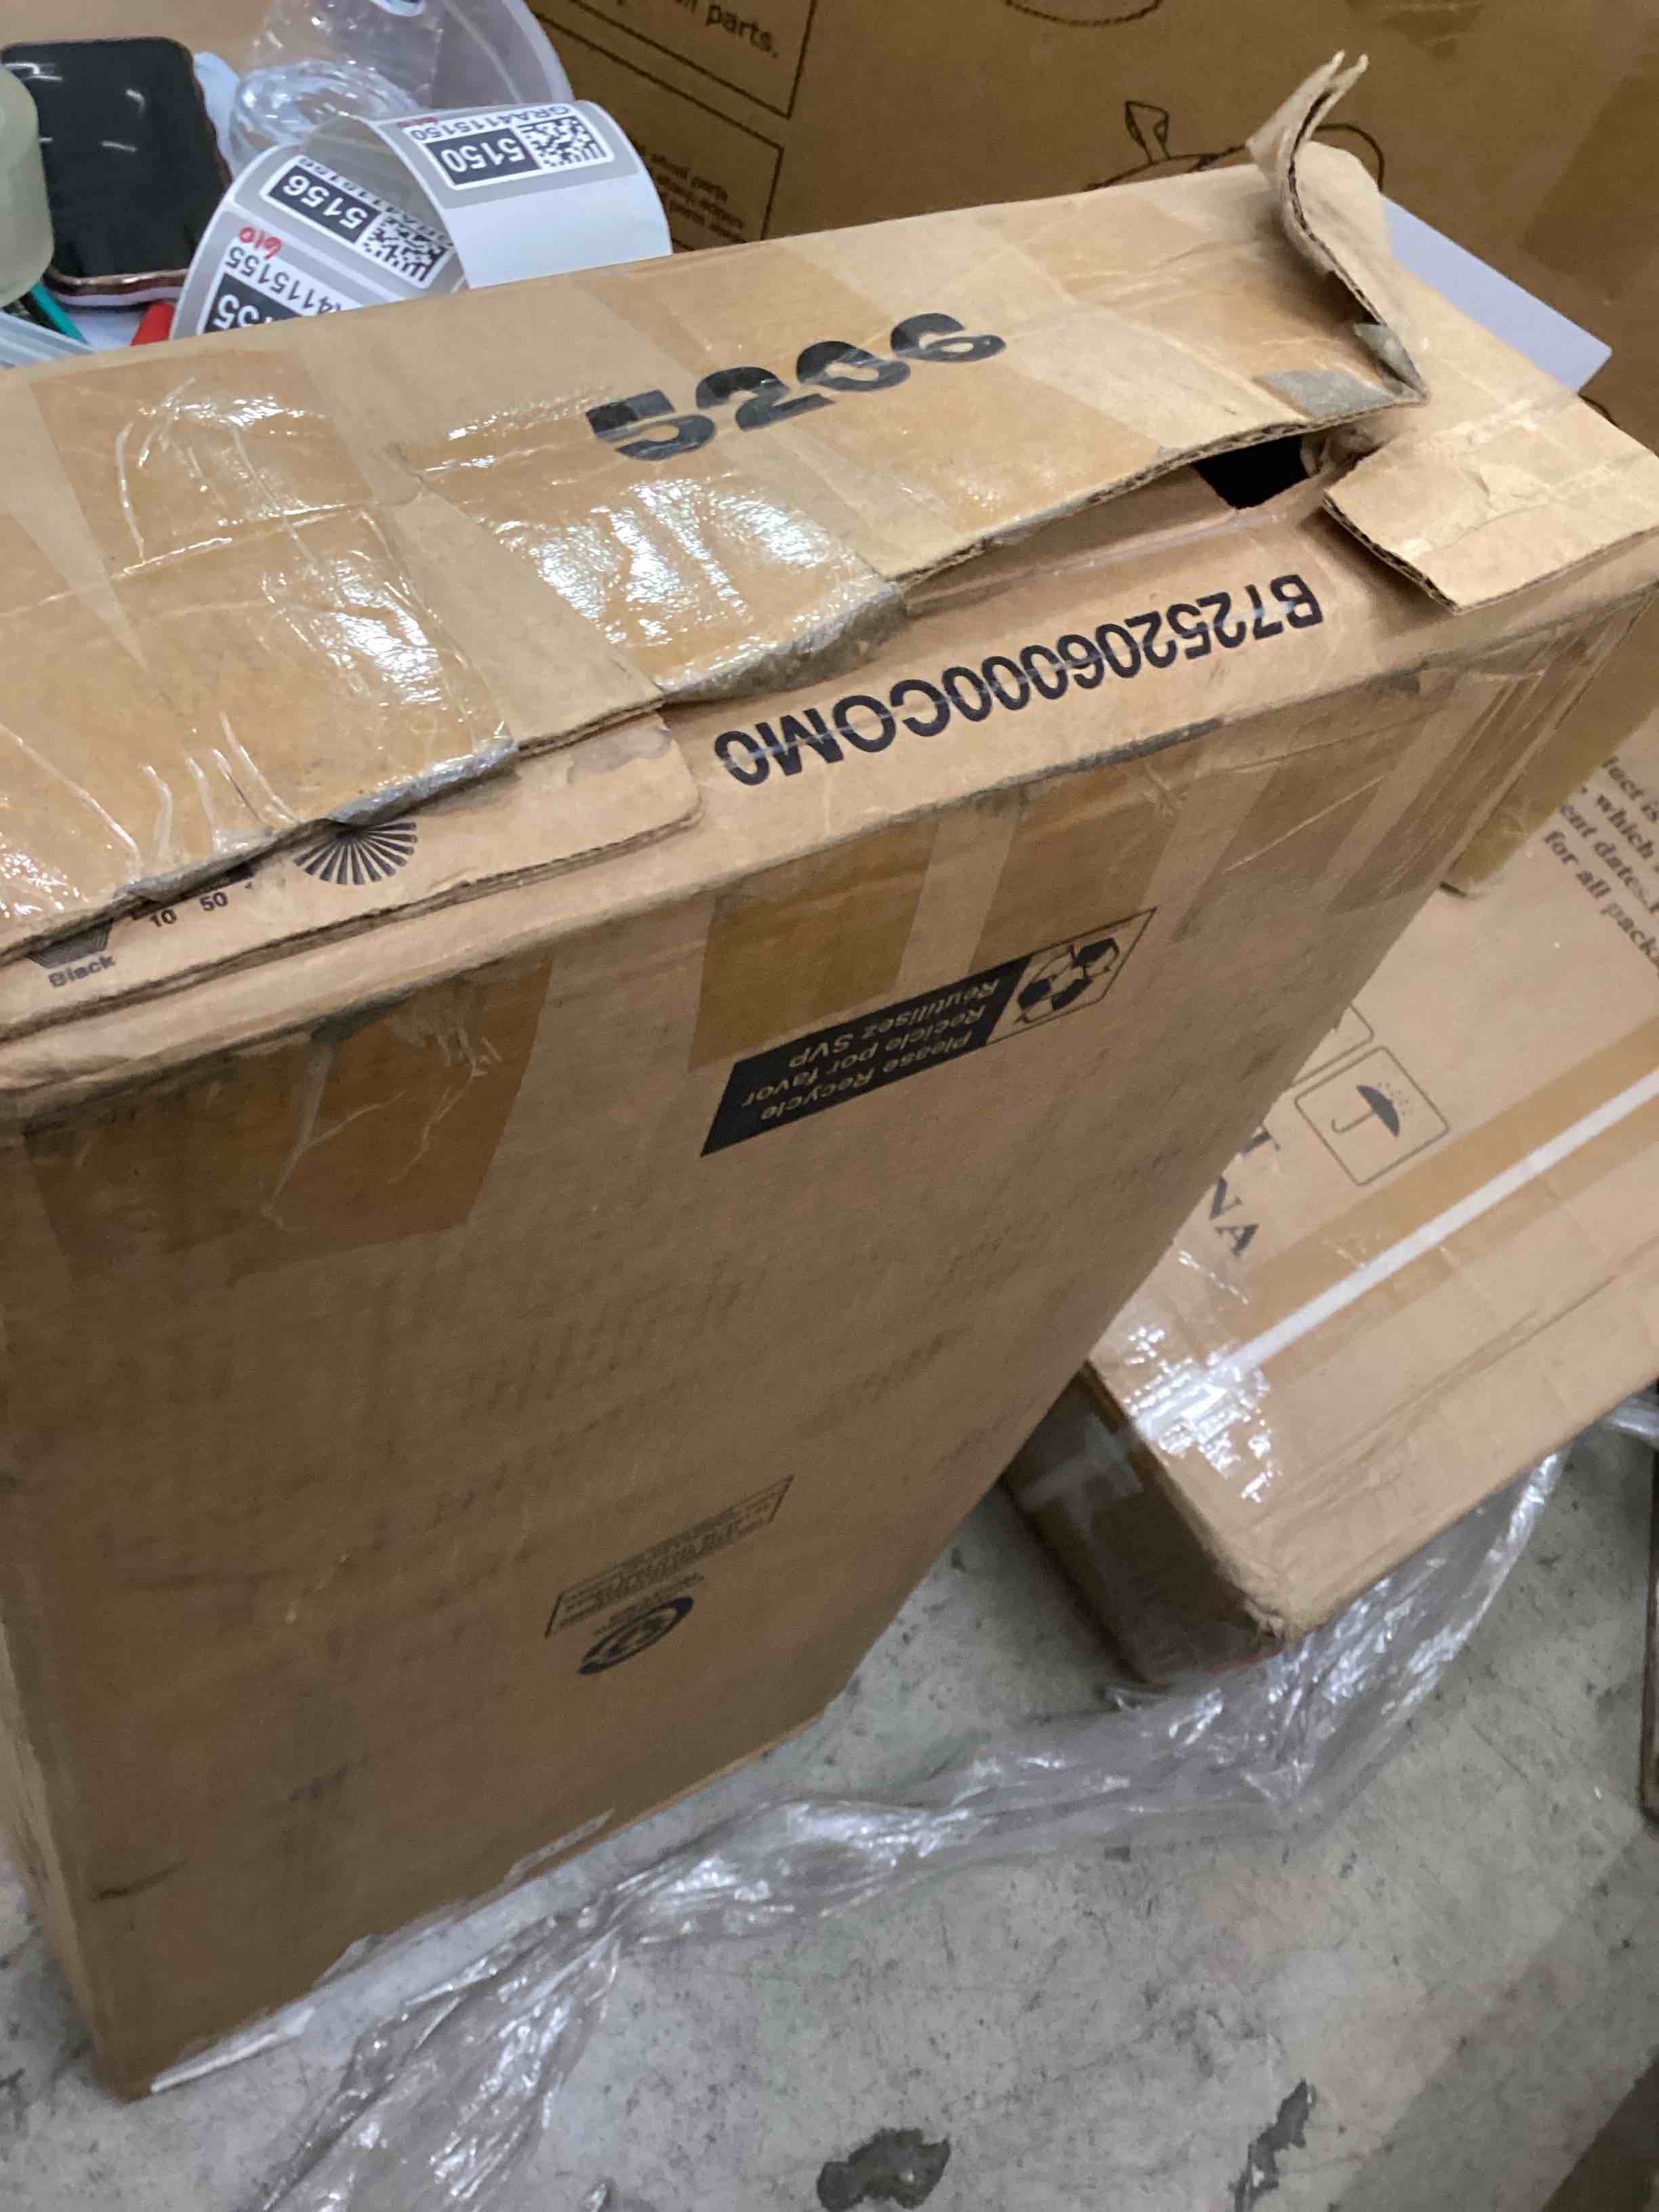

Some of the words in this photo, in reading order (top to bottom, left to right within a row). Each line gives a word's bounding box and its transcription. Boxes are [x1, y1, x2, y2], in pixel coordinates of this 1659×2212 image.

[440, 136, 527, 173] 5150
[282, 174, 369, 230] 5156
[585, 312, 1007, 461] 5206
[1596, 794, 1654, 859] which
[1544, 832, 1579, 864] for
[1576, 871, 1612, 900] all
[149, 909, 177, 928] 10
[199, 890, 229, 912] 50
[47, 951, 115, 988] Black
[787, 1031, 855, 1069] SVP
[825, 1042, 879, 1077] por
[882, 1029, 972, 1073] Please
[739, 1067, 819, 1109] favor
[759, 1067, 875, 1121] Recycle
